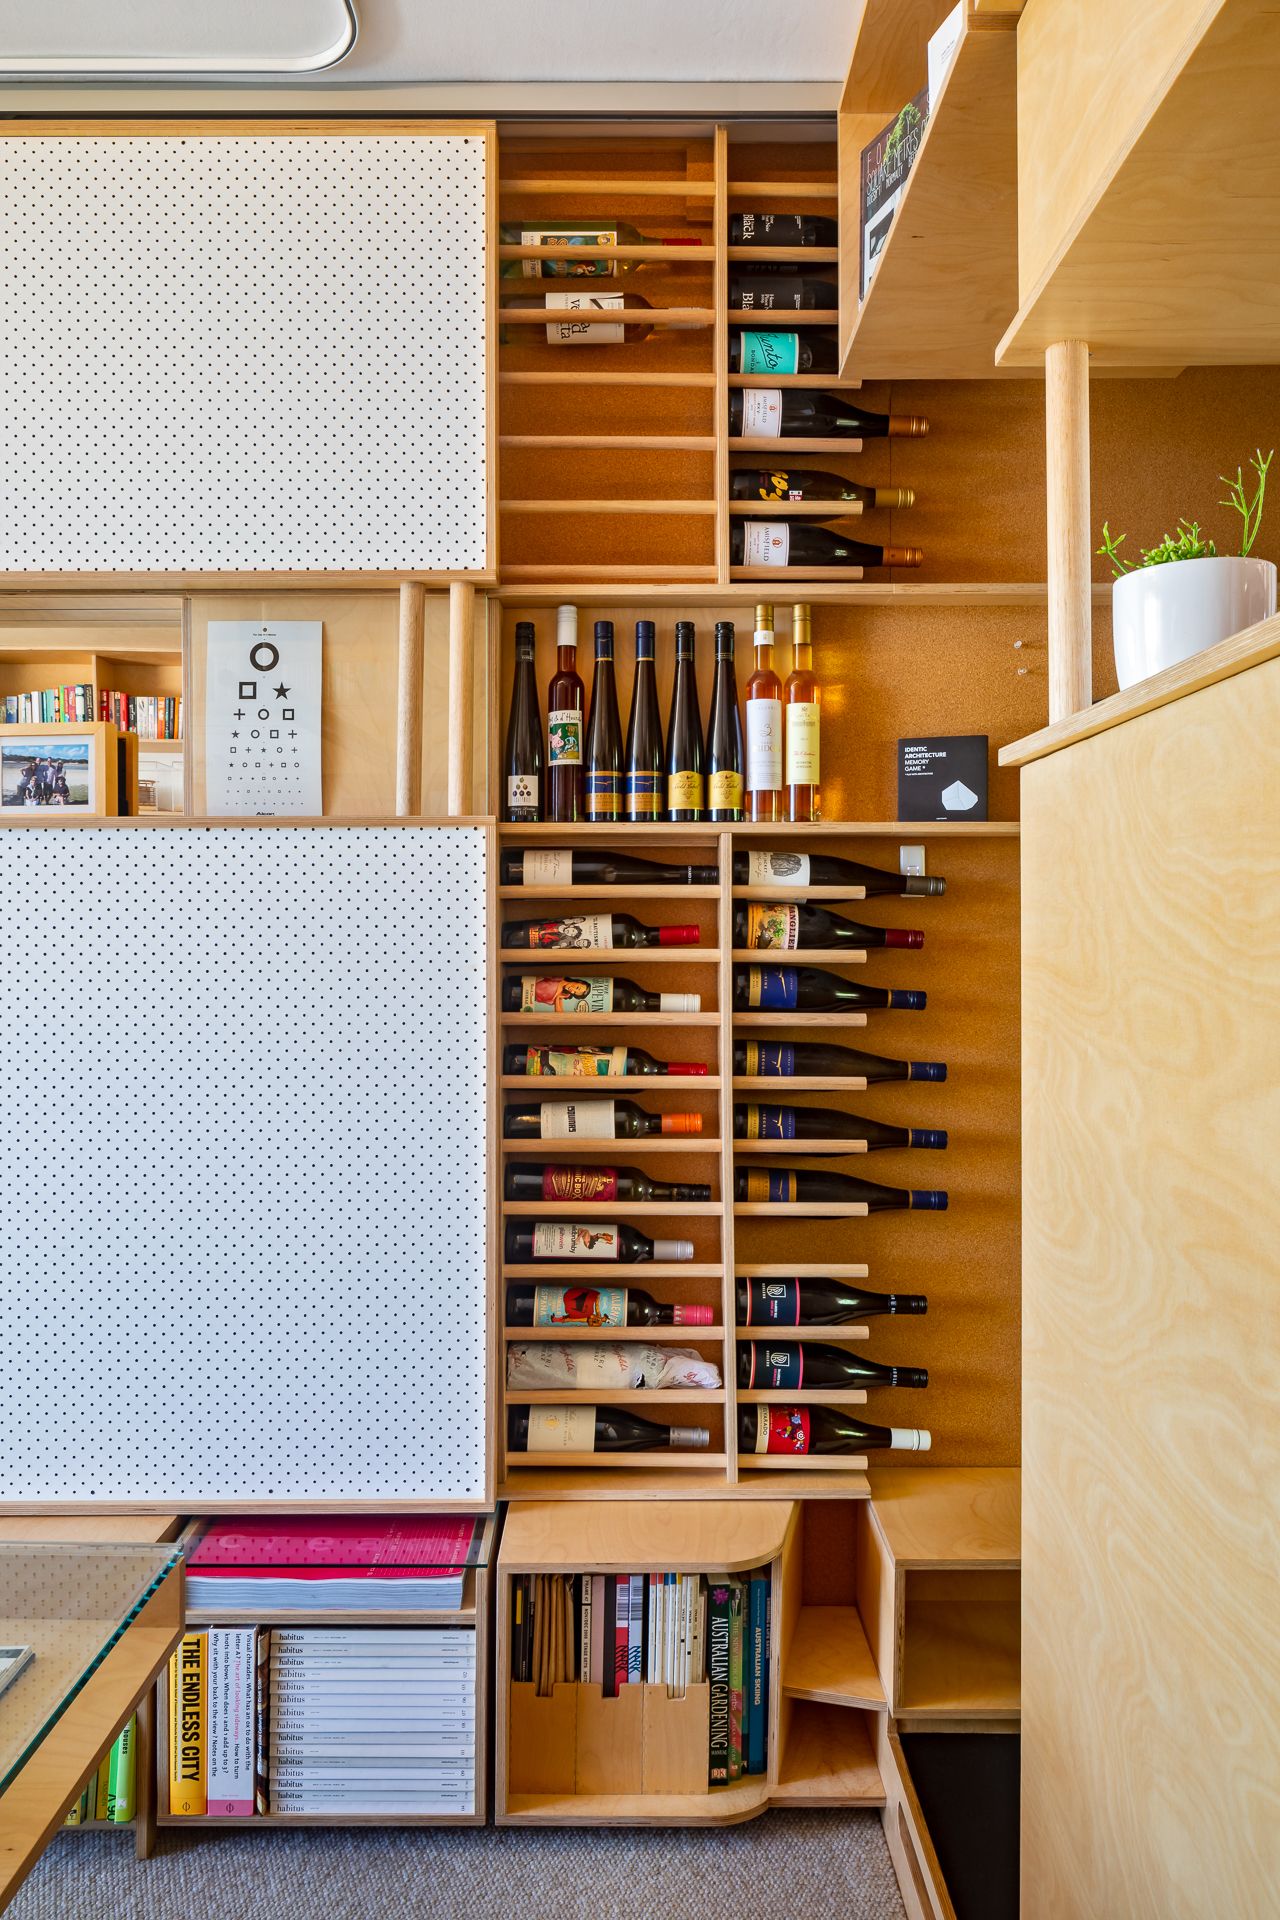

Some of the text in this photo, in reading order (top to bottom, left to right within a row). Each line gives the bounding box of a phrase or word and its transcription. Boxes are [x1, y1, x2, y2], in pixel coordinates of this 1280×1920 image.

[742, 292, 753, 310] Bla
[211, 1633, 219, 1646] Why
[628, 1645, 641, 1675] MARK
[754, 1627, 762, 1677] AUSTRALIAN
[278, 1670, 306, 1678] habitus
[710, 1616, 728, 1748] AUSTRALIAN GARDENING
[182, 1639, 200, 1782] THE ENDLESS CITY
[277, 1708, 304, 1716] habitus
[277, 1721, 304, 1729] habitus
[122, 1730, 130, 1754] houses
[277, 1804, 304, 1812] habitus
